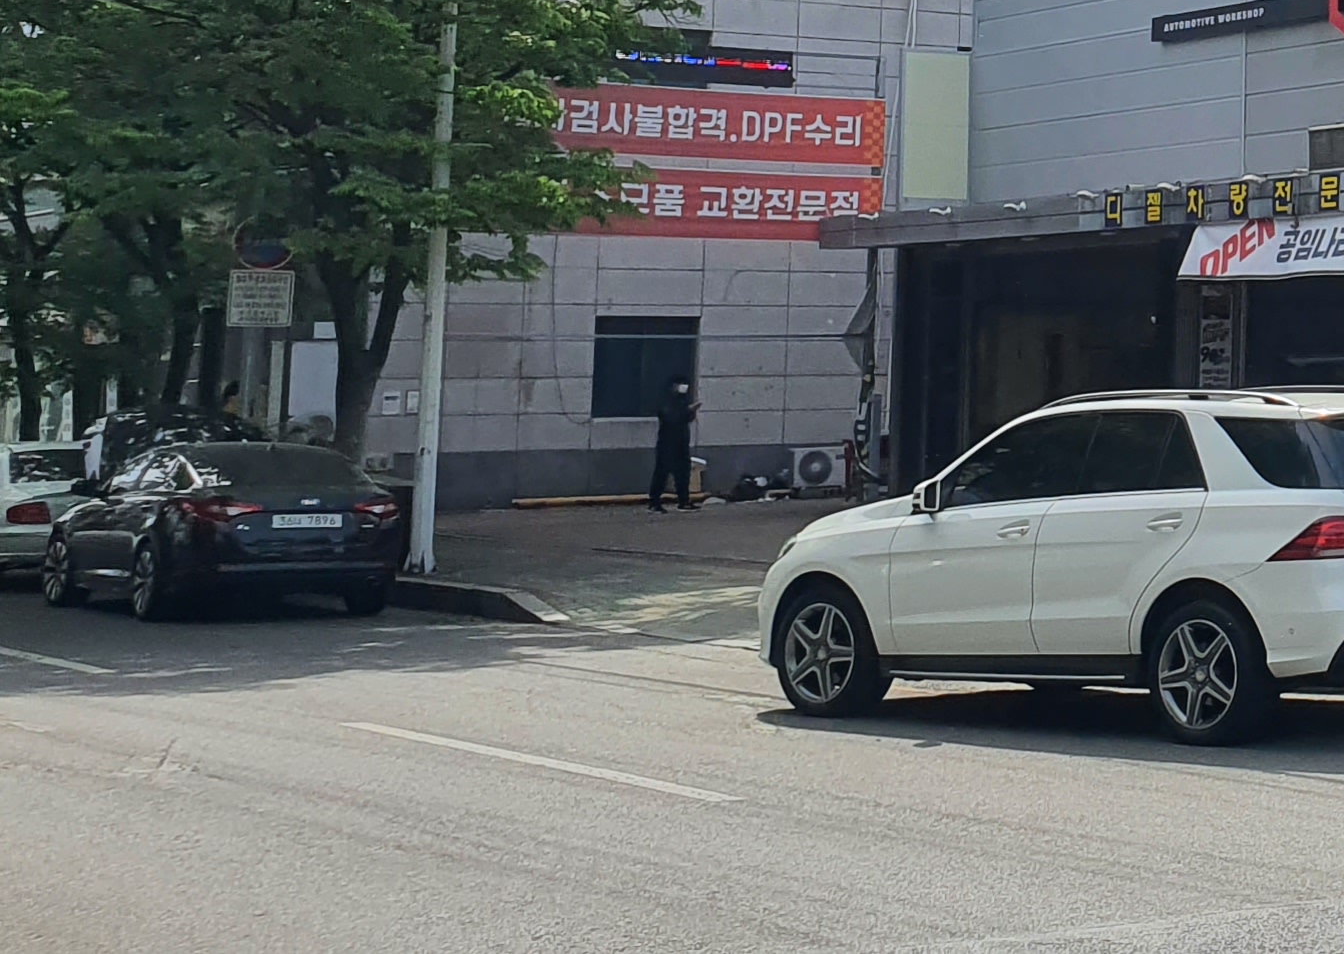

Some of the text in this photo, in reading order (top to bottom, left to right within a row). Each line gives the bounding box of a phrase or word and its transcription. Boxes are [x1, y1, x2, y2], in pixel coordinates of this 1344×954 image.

[1163, 7, 1265, 33] AUTOMOTIVE WORKSHOP
[1200, 218, 1276, 276] OPEN
